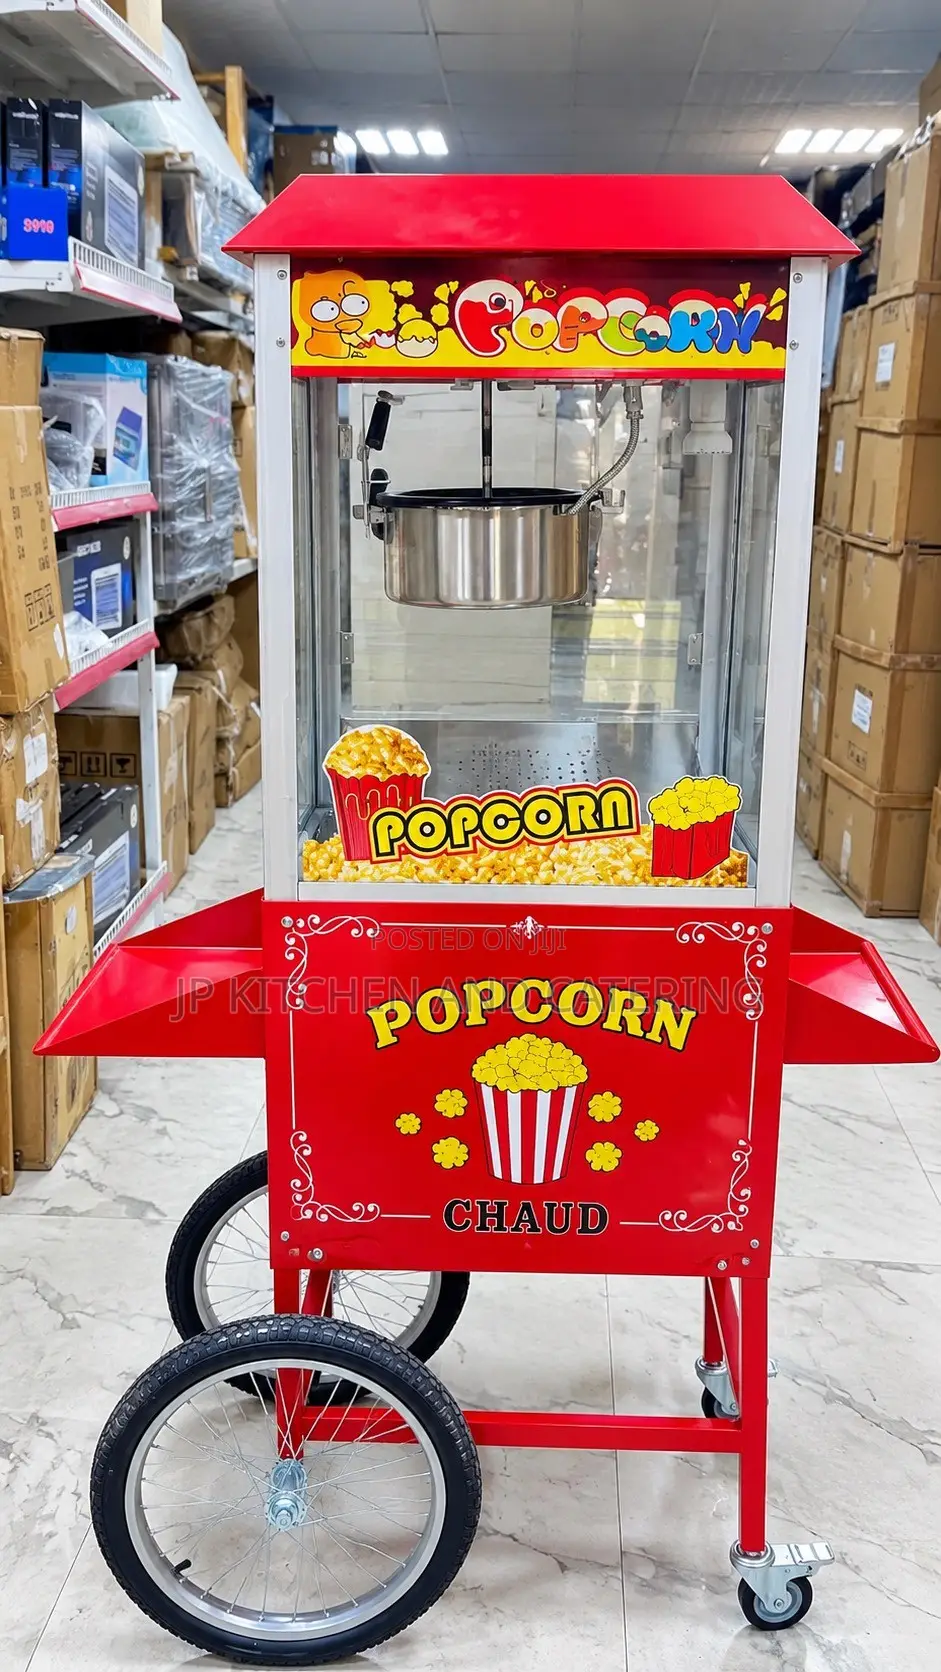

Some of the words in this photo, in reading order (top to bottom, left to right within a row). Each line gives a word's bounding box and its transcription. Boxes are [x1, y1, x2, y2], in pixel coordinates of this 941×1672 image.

[454, 279, 768, 357] POPCORN
[371, 786, 634, 858] POPCORN
[366, 977, 697, 1052] POPCORN
[443, 1198, 610, 1236] CHAUD
